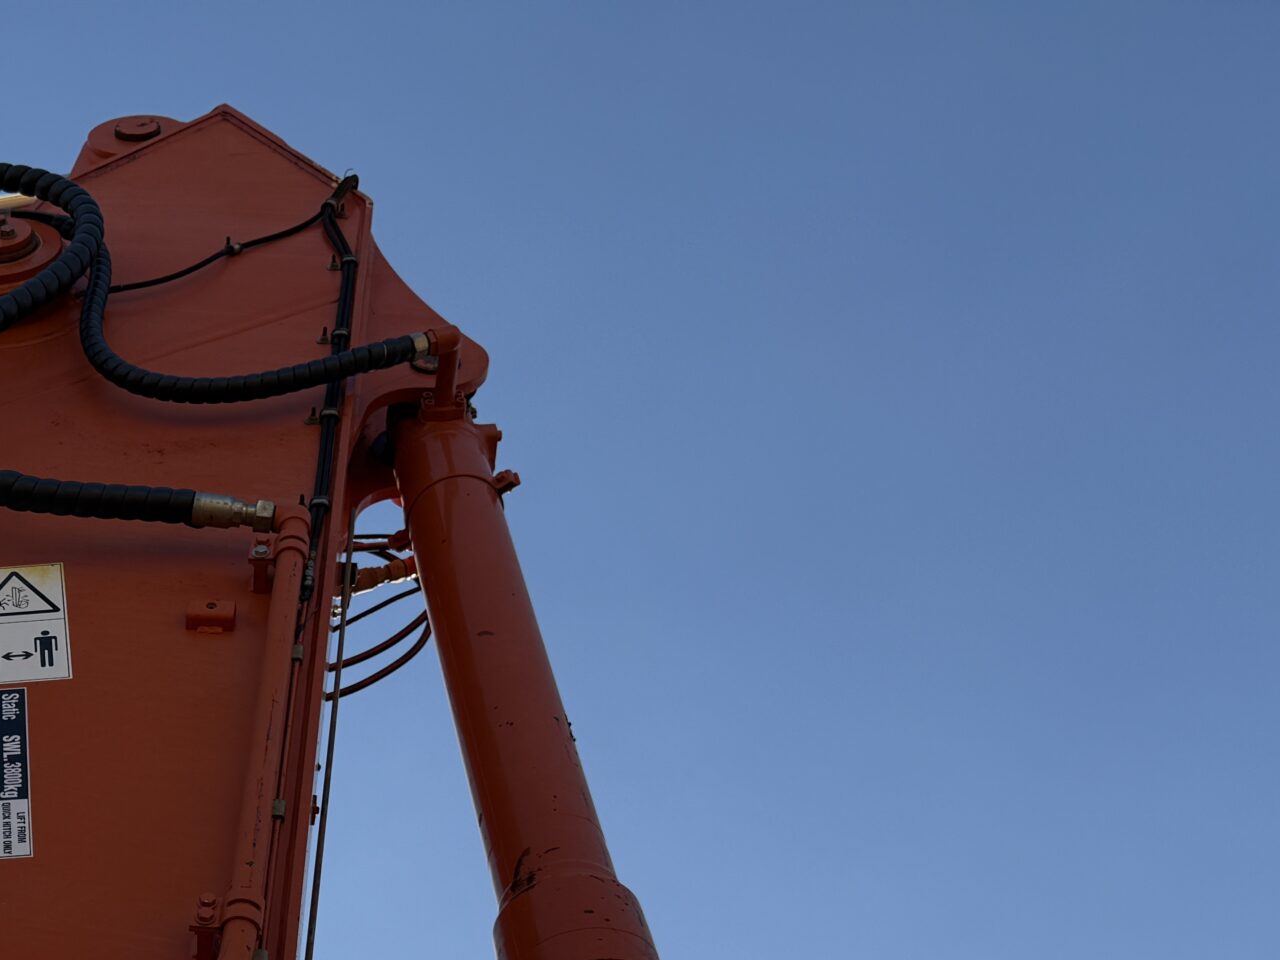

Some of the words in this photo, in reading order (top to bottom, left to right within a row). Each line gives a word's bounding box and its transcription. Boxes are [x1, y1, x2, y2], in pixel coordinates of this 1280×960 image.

[1, 693, 19, 720] Static
[2, 803, 11, 820] QUICK
[17, 812, 25, 824] LIFT
[3, 821, 11, 839] HITCH
[17, 826, 26, 843] FROM
[3, 841, 12, 854] ONLY
